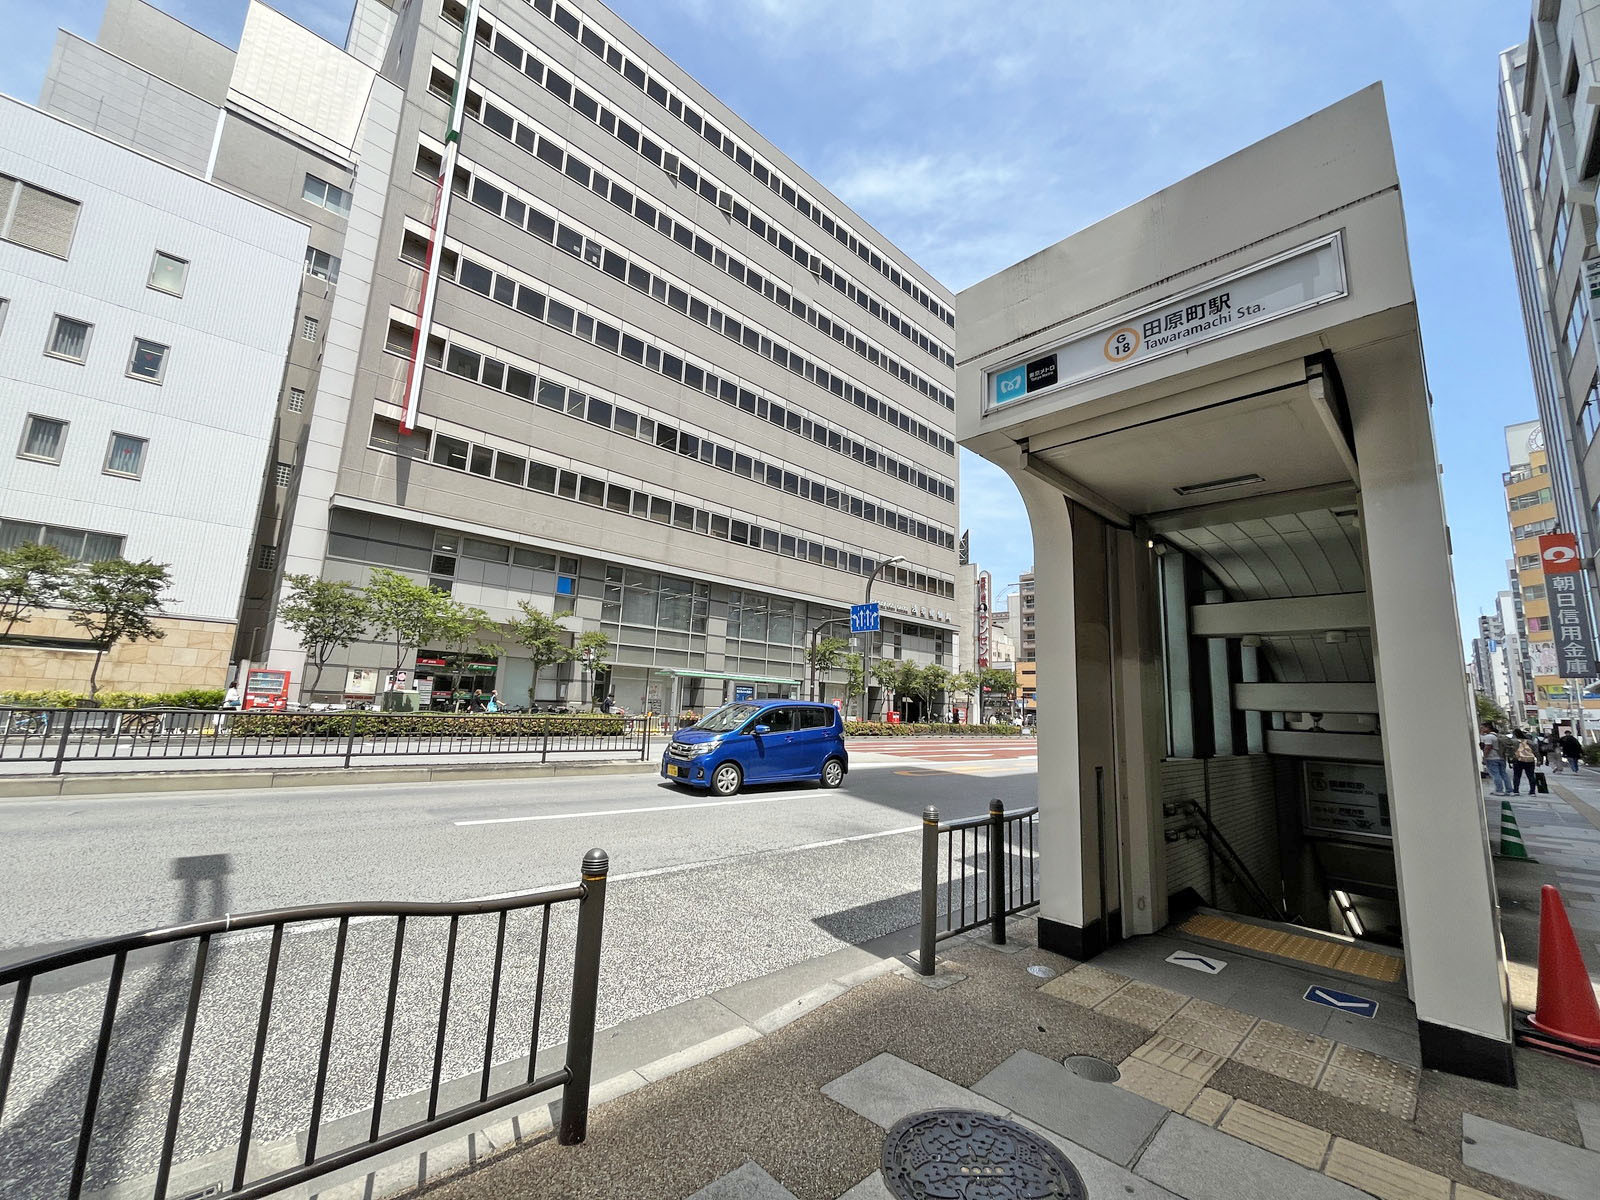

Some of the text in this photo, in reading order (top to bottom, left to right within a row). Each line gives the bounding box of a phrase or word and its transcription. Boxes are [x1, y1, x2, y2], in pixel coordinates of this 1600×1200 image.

[1116, 333, 1127, 344] G
[1143, 292, 1231, 340] 田原町駅
[1145, 302, 1266, 351] Tawaramachi Sta.
[1114, 342, 1131, 356] 18
[1552, 575, 1589, 675] 朝日信用金庫
